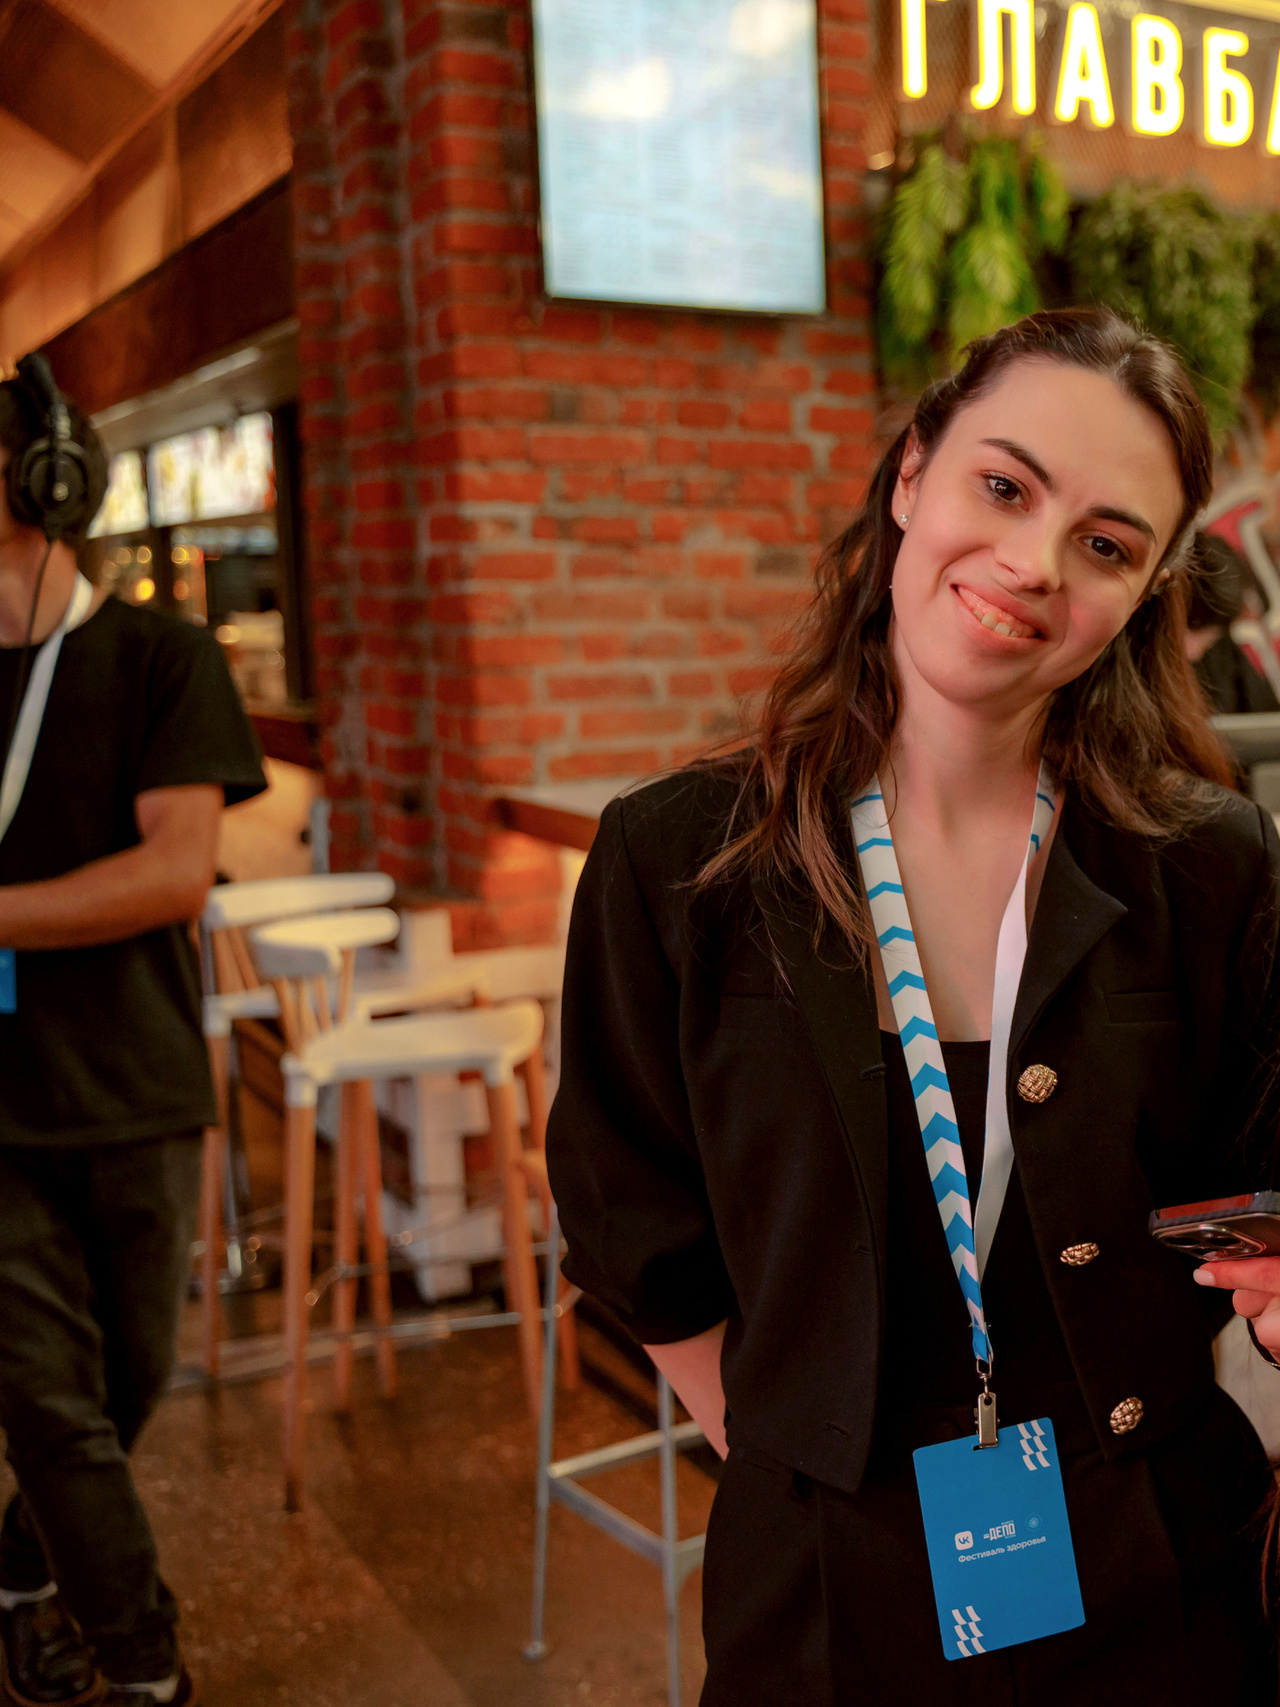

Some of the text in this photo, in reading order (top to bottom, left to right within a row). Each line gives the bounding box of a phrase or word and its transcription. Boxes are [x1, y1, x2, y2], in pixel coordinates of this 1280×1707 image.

[957, 1535, 971, 1545] VK
[988, 1522, 1016, 1541] ДЕПО
[958, 1536, 1046, 1563] Фестиваль здоровья
